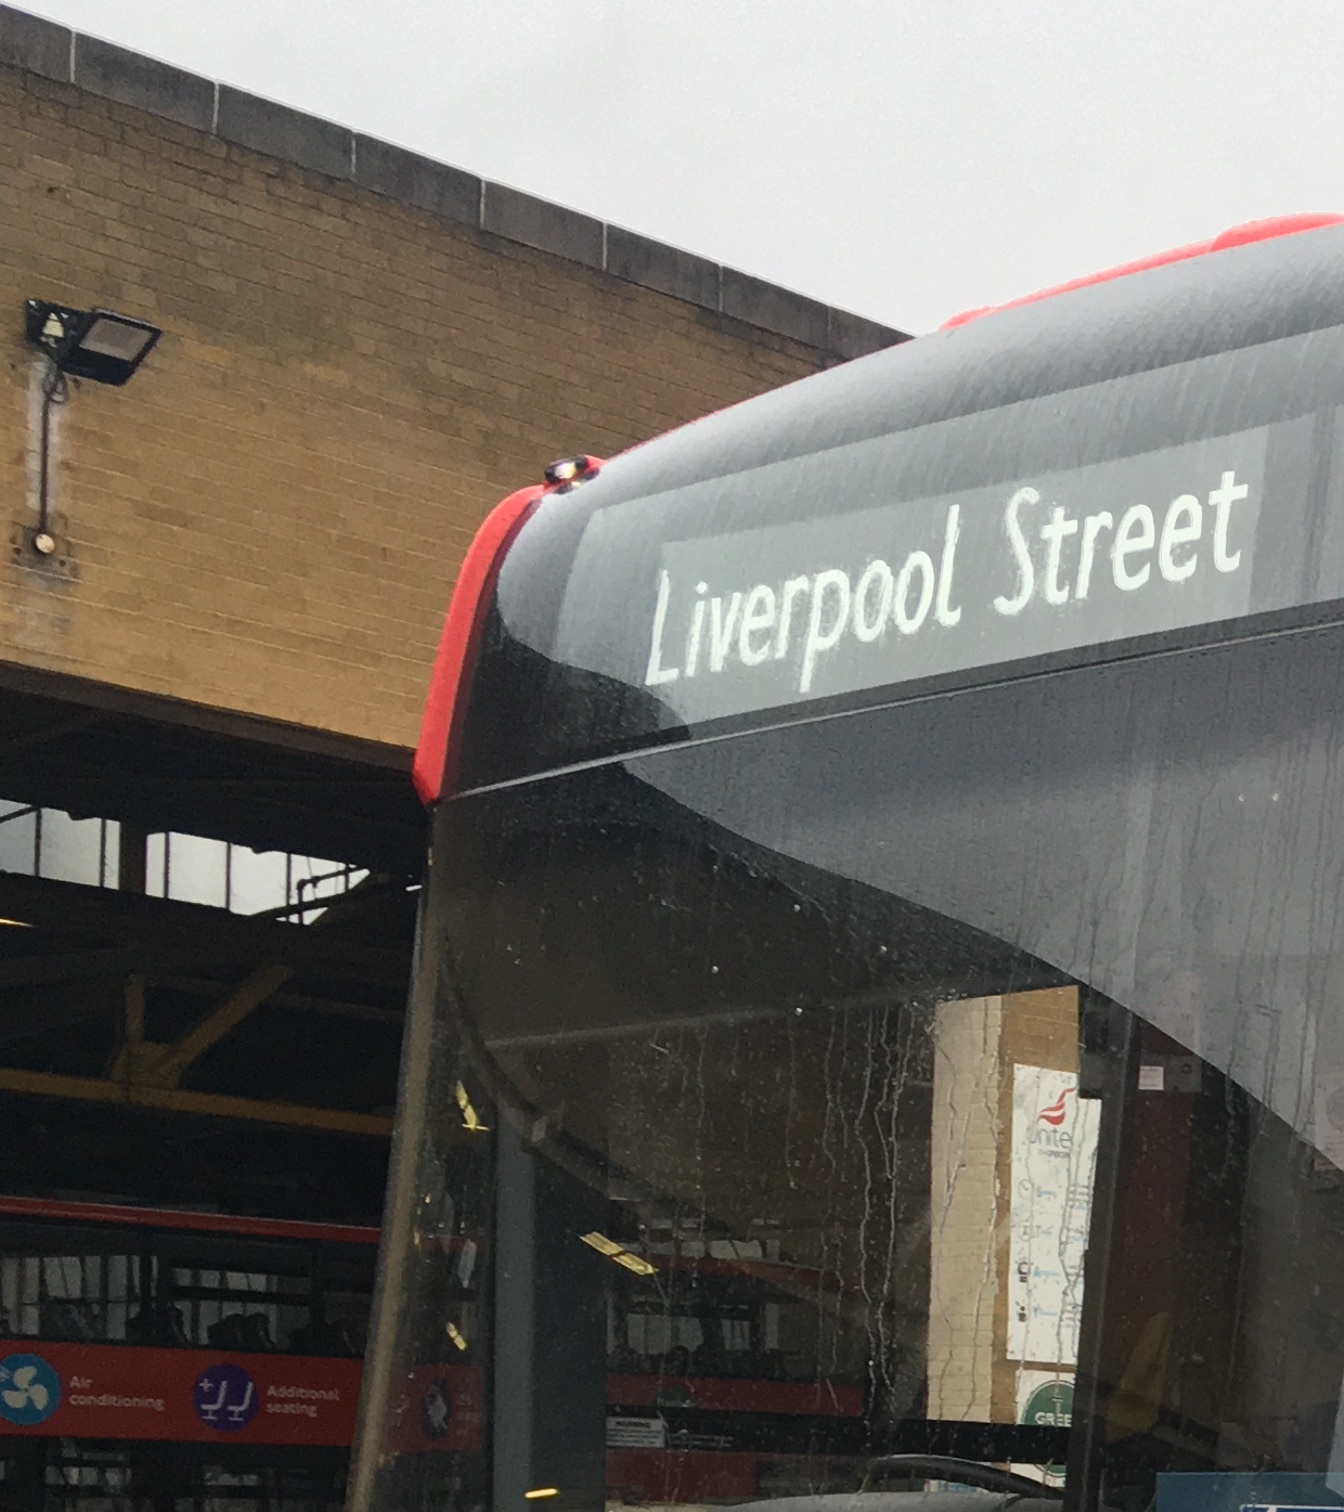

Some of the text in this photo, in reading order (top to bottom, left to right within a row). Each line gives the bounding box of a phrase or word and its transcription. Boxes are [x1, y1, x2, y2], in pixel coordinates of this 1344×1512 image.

[644, 470, 1249, 693] Liverpool Street
[69, 1375, 92, 1389] Air
[267, 1385, 341, 1401] Additional
[69, 1393, 166, 1412] conditioning
[266, 1402, 318, 1418] seating
